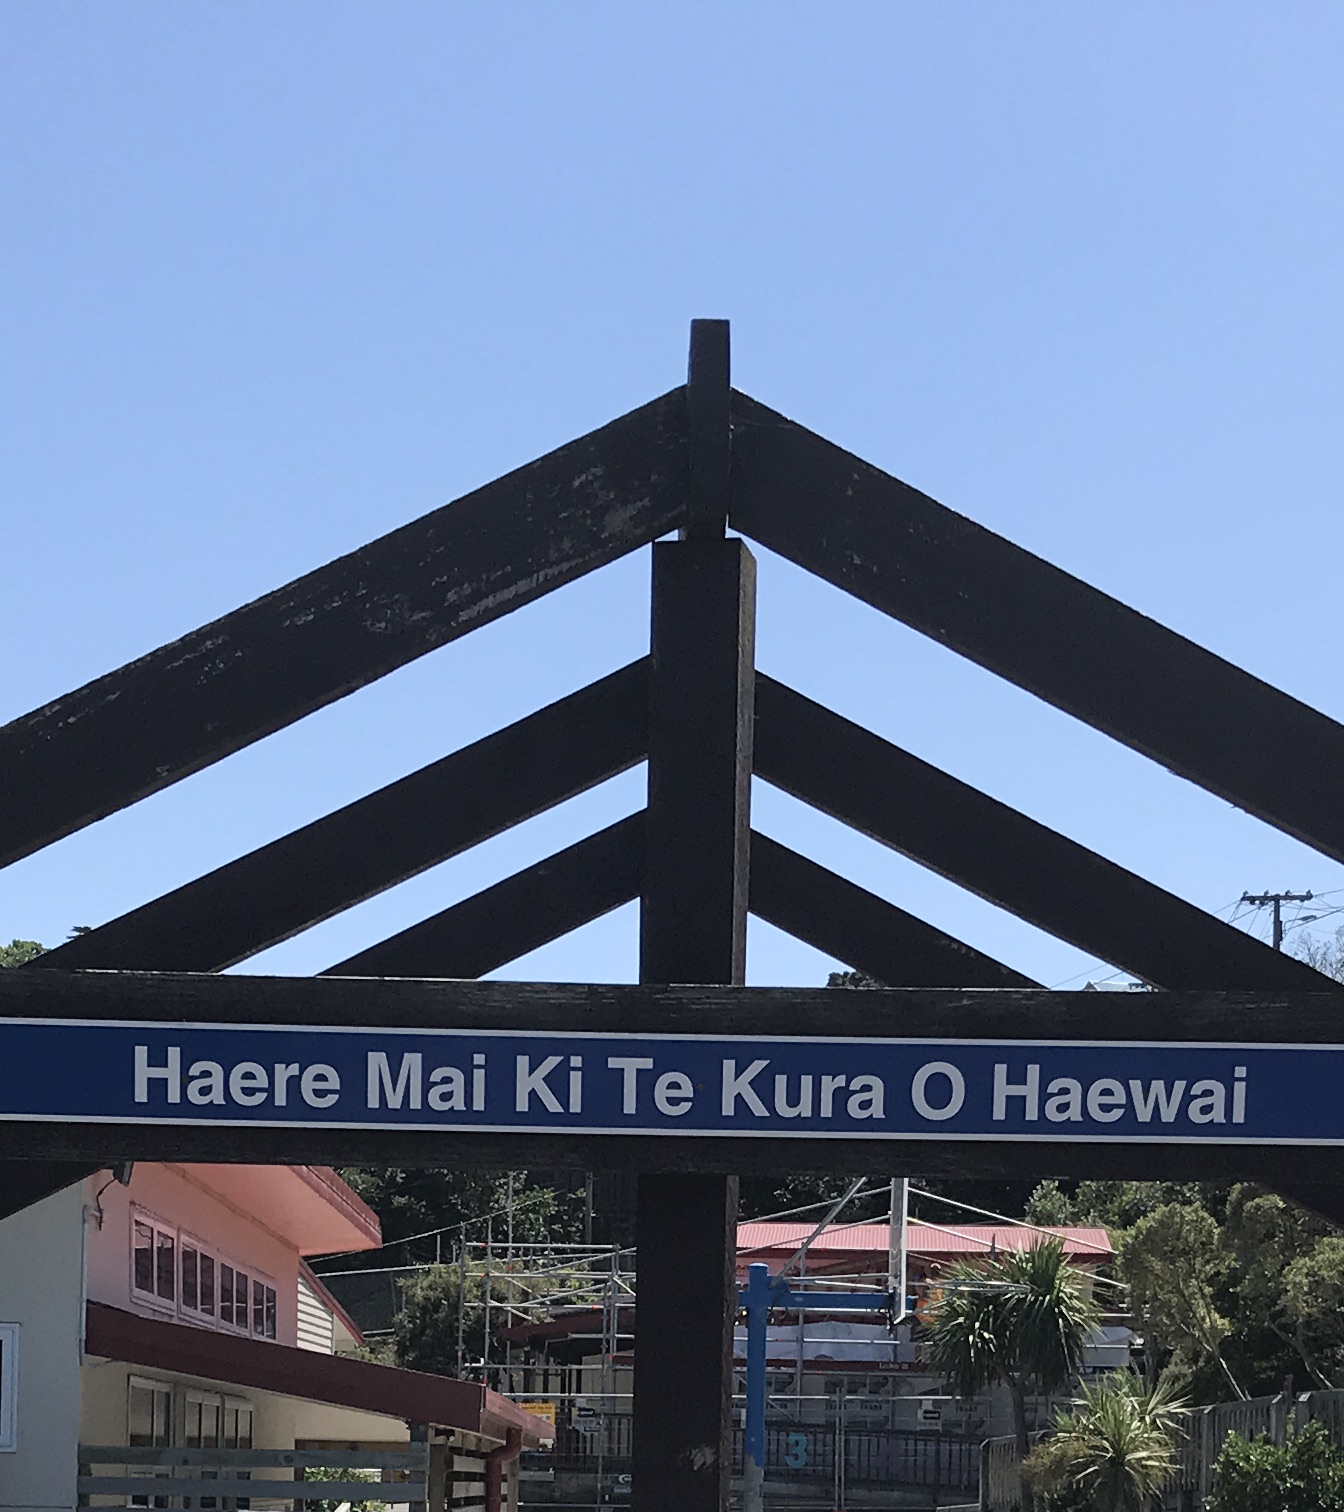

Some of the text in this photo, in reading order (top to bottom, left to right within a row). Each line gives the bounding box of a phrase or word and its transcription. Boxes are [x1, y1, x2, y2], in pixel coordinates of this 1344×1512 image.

[133, 1045, 1247, 1124] Haere Mai Ki Te Kura O Haewai
[784, 1432, 807, 1469] 3
